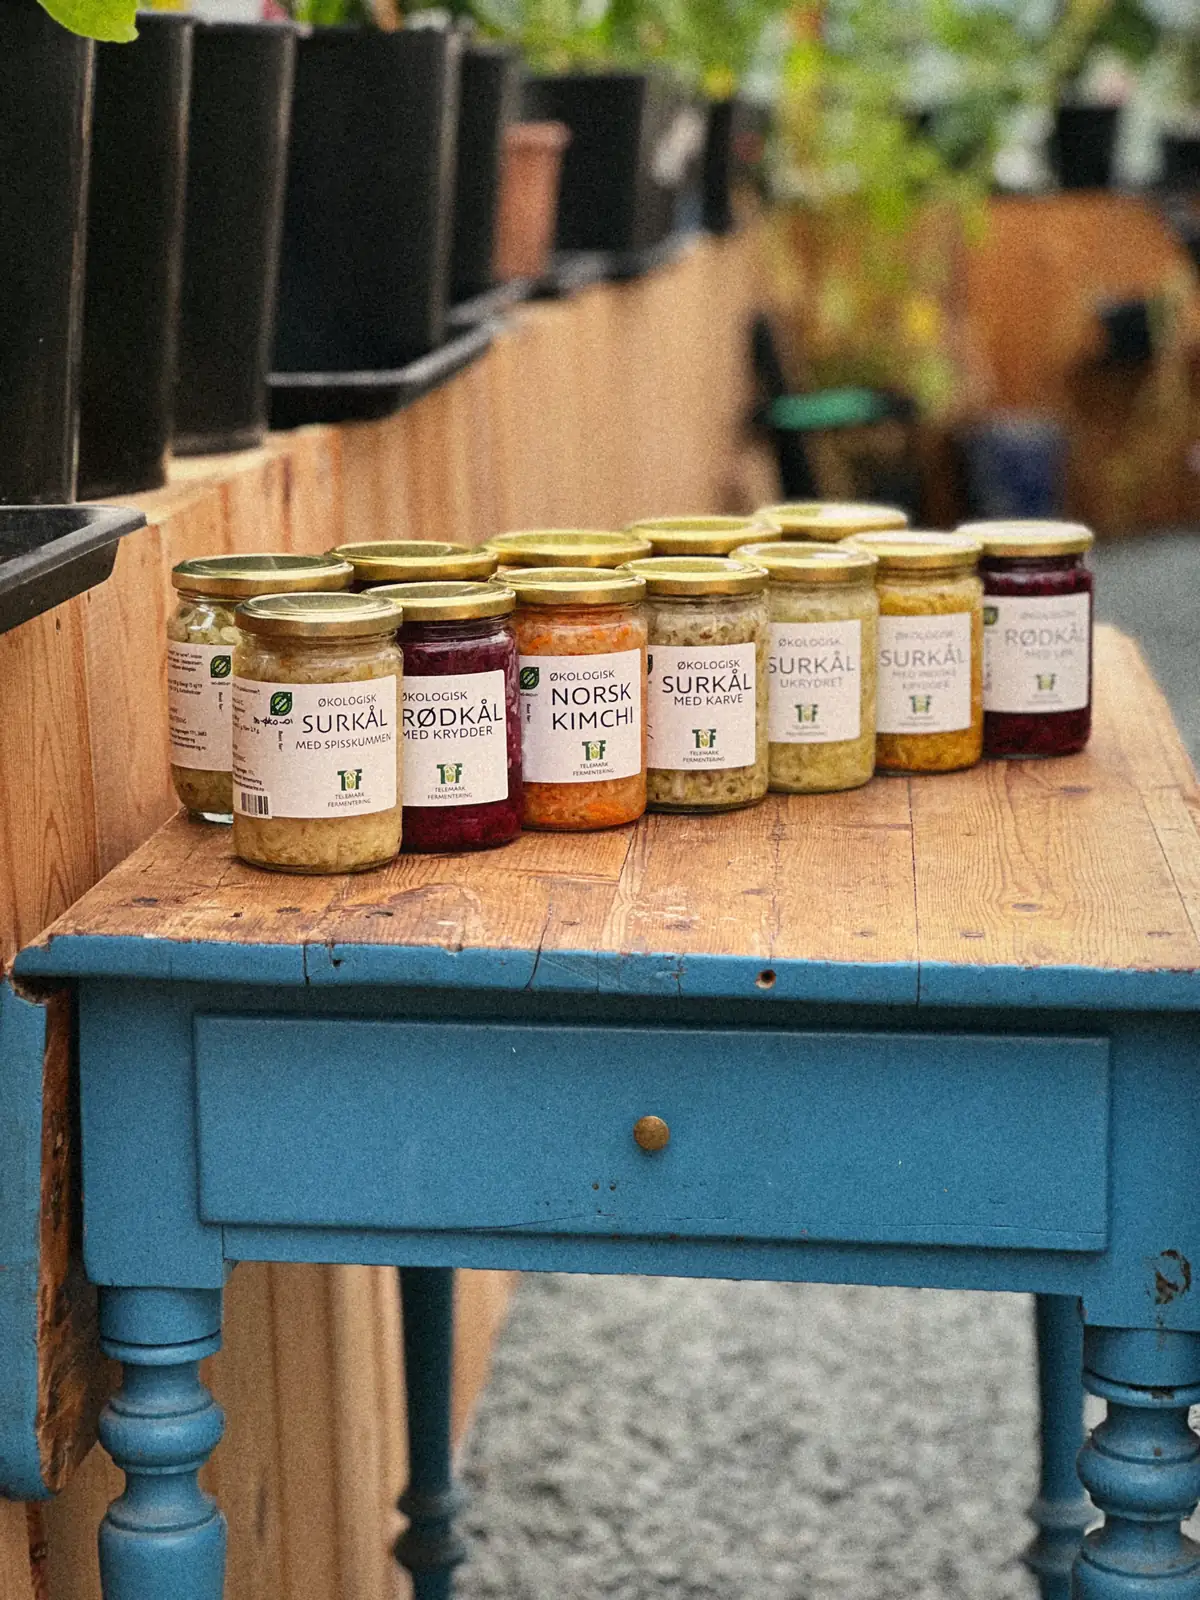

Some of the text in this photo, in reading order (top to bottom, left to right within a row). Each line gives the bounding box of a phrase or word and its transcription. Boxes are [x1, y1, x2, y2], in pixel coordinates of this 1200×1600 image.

[880, 642, 966, 667] SURKÅL
[677, 659, 741, 670] ØKOLOGISK
[768, 650, 856, 674] SURKÅL
[549, 670, 615, 681] ØKOLOGISK
[662, 668, 752, 694] SURKÅL
[780, 677, 843, 688] UKRYDRET
[318, 693, 377, 708] ØKOLOGISK
[552, 682, 631, 706] NORSK
[674, 693, 743, 706] MED KARVE
[302, 705, 388, 734] SURKÅL
[402, 699, 503, 728] RØDKÅL
[552, 706, 633, 730] KIMCHI
[402, 726, 493, 740] MED KRYDDER
[295, 732, 392, 750] MED SPISSKUMMEN
[573, 768, 614, 776] FERMENTERING
[335, 792, 365, 800] TELEMARK
[427, 792, 473, 800] FERMENTERING
[327, 799, 372, 808] FERMENTERING
